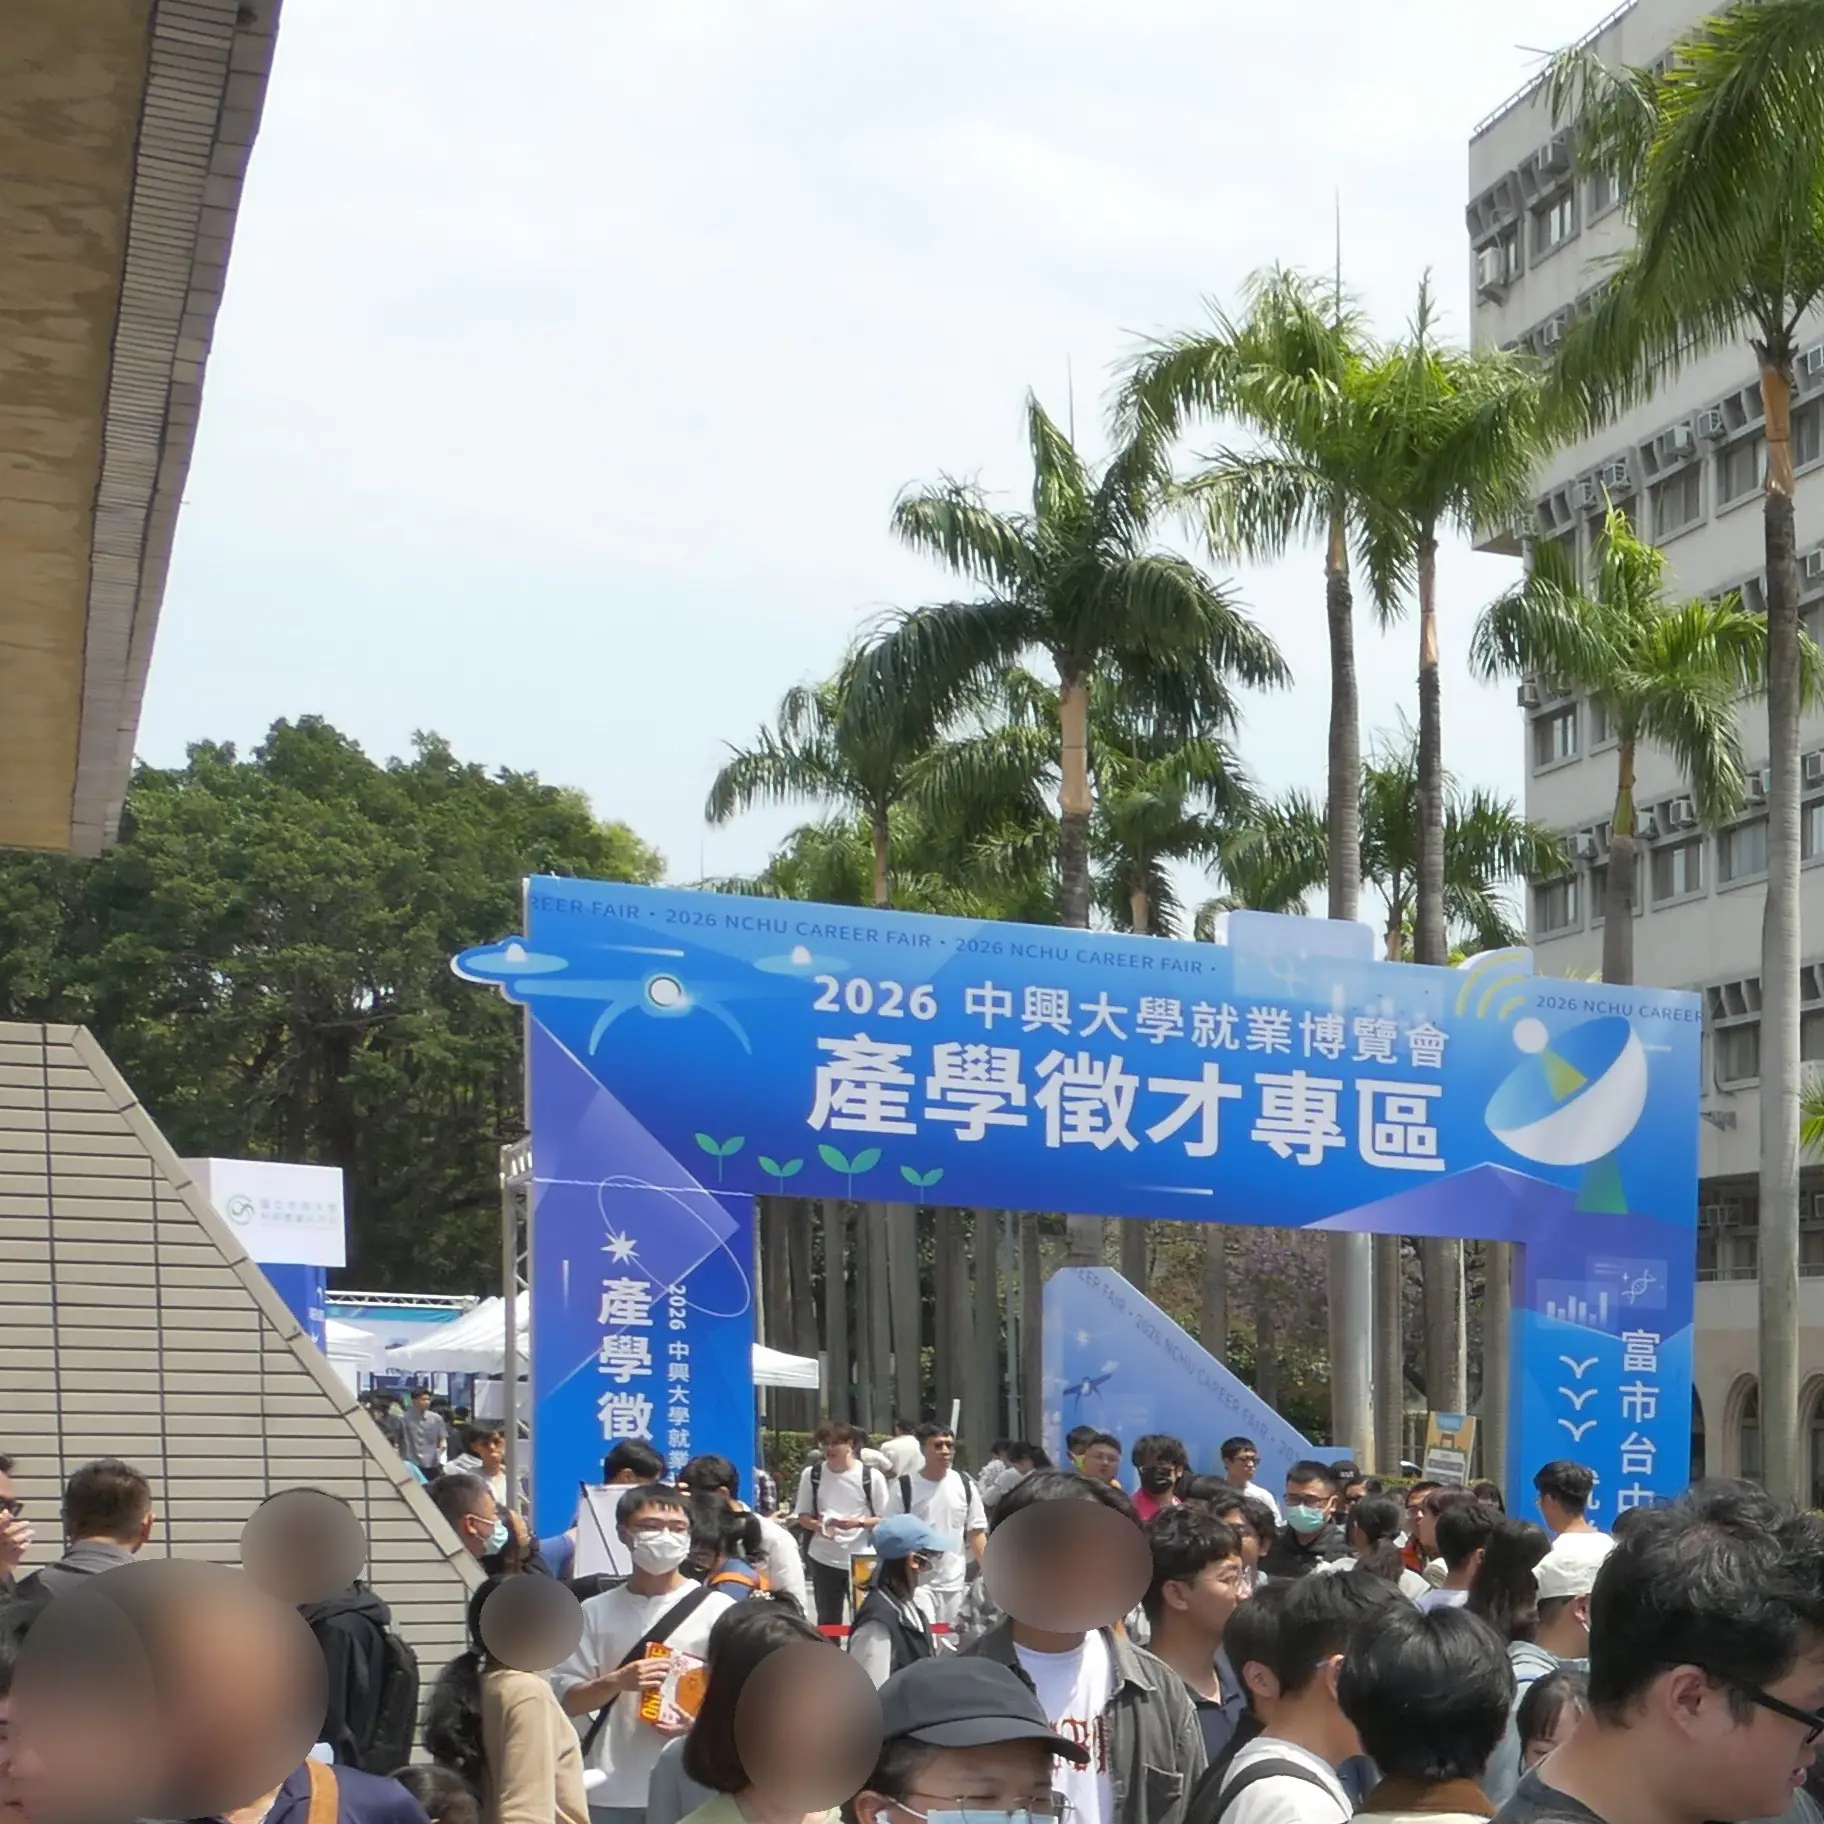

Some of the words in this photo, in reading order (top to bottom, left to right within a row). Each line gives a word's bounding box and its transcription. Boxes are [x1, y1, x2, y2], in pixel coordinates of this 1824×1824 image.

[592, 901, 640, 921] FAIR
[665, 908, 718, 928] 2026
[725, 916, 788, 935] NCHU
[795, 920, 879, 945] CAREER
[886, 930, 931, 949] FAIR
[956, 937, 1004, 956] 2026
[1010, 942, 1069, 962] NCHU
[1076, 949, 1154, 971] CAREER
[1160, 956, 1203, 975] FAIR
[811, 974, 938, 1021] 2026
[964, 979, 1450, 1069] 中興大學就業博覽會
[1536, 995, 1578, 1010] 2026
[1583, 1000, 1634, 1016] NCHU
[806, 1032, 1446, 1172] 產學徵才專區
[668, 1283, 687, 1331] 2026
[597, 1277, 655, 1467] 產學徵
[668, 1340, 690, 1485] 中興大學就業
